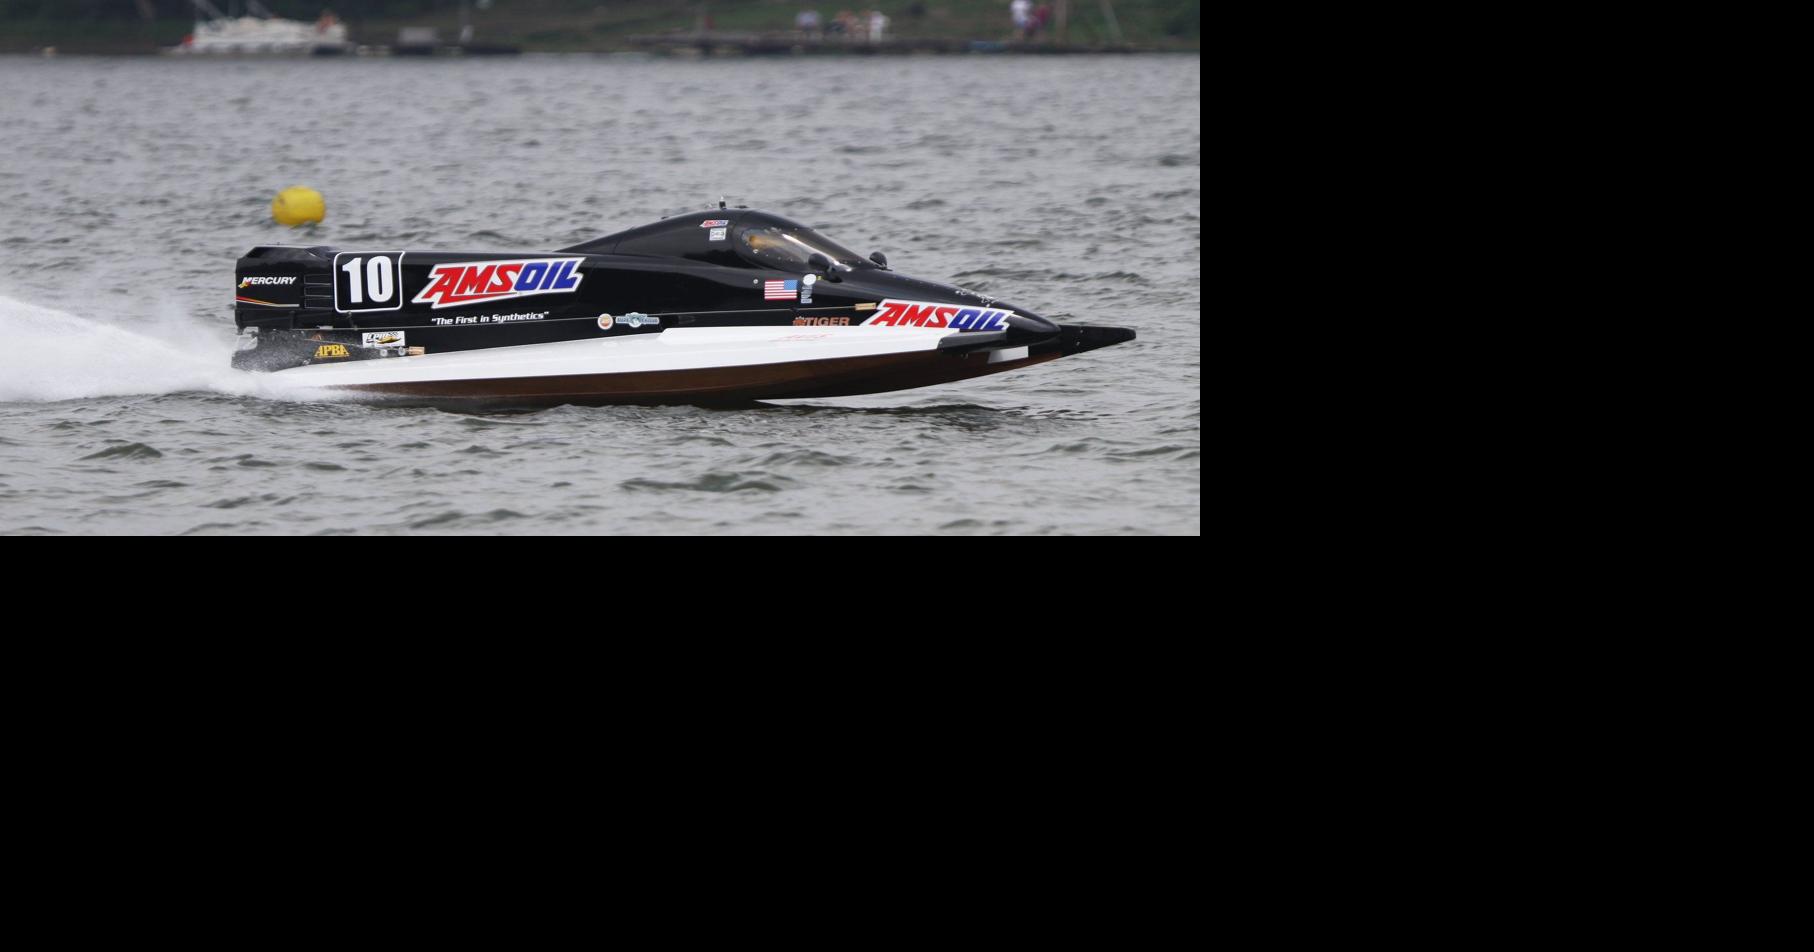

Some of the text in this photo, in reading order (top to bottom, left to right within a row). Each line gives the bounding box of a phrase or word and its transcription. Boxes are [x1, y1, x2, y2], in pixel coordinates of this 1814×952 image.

[240, 276, 297, 286] MERCURY
[342, 256, 394, 303] 10
[422, 260, 579, 305] AMSOIL
[455, 315, 478, 324] First
[480, 314, 490, 323] in
[805, 317, 850, 326] TIGER
[870, 302, 1010, 331] AMSOIL
[314, 344, 350, 358] APBA
